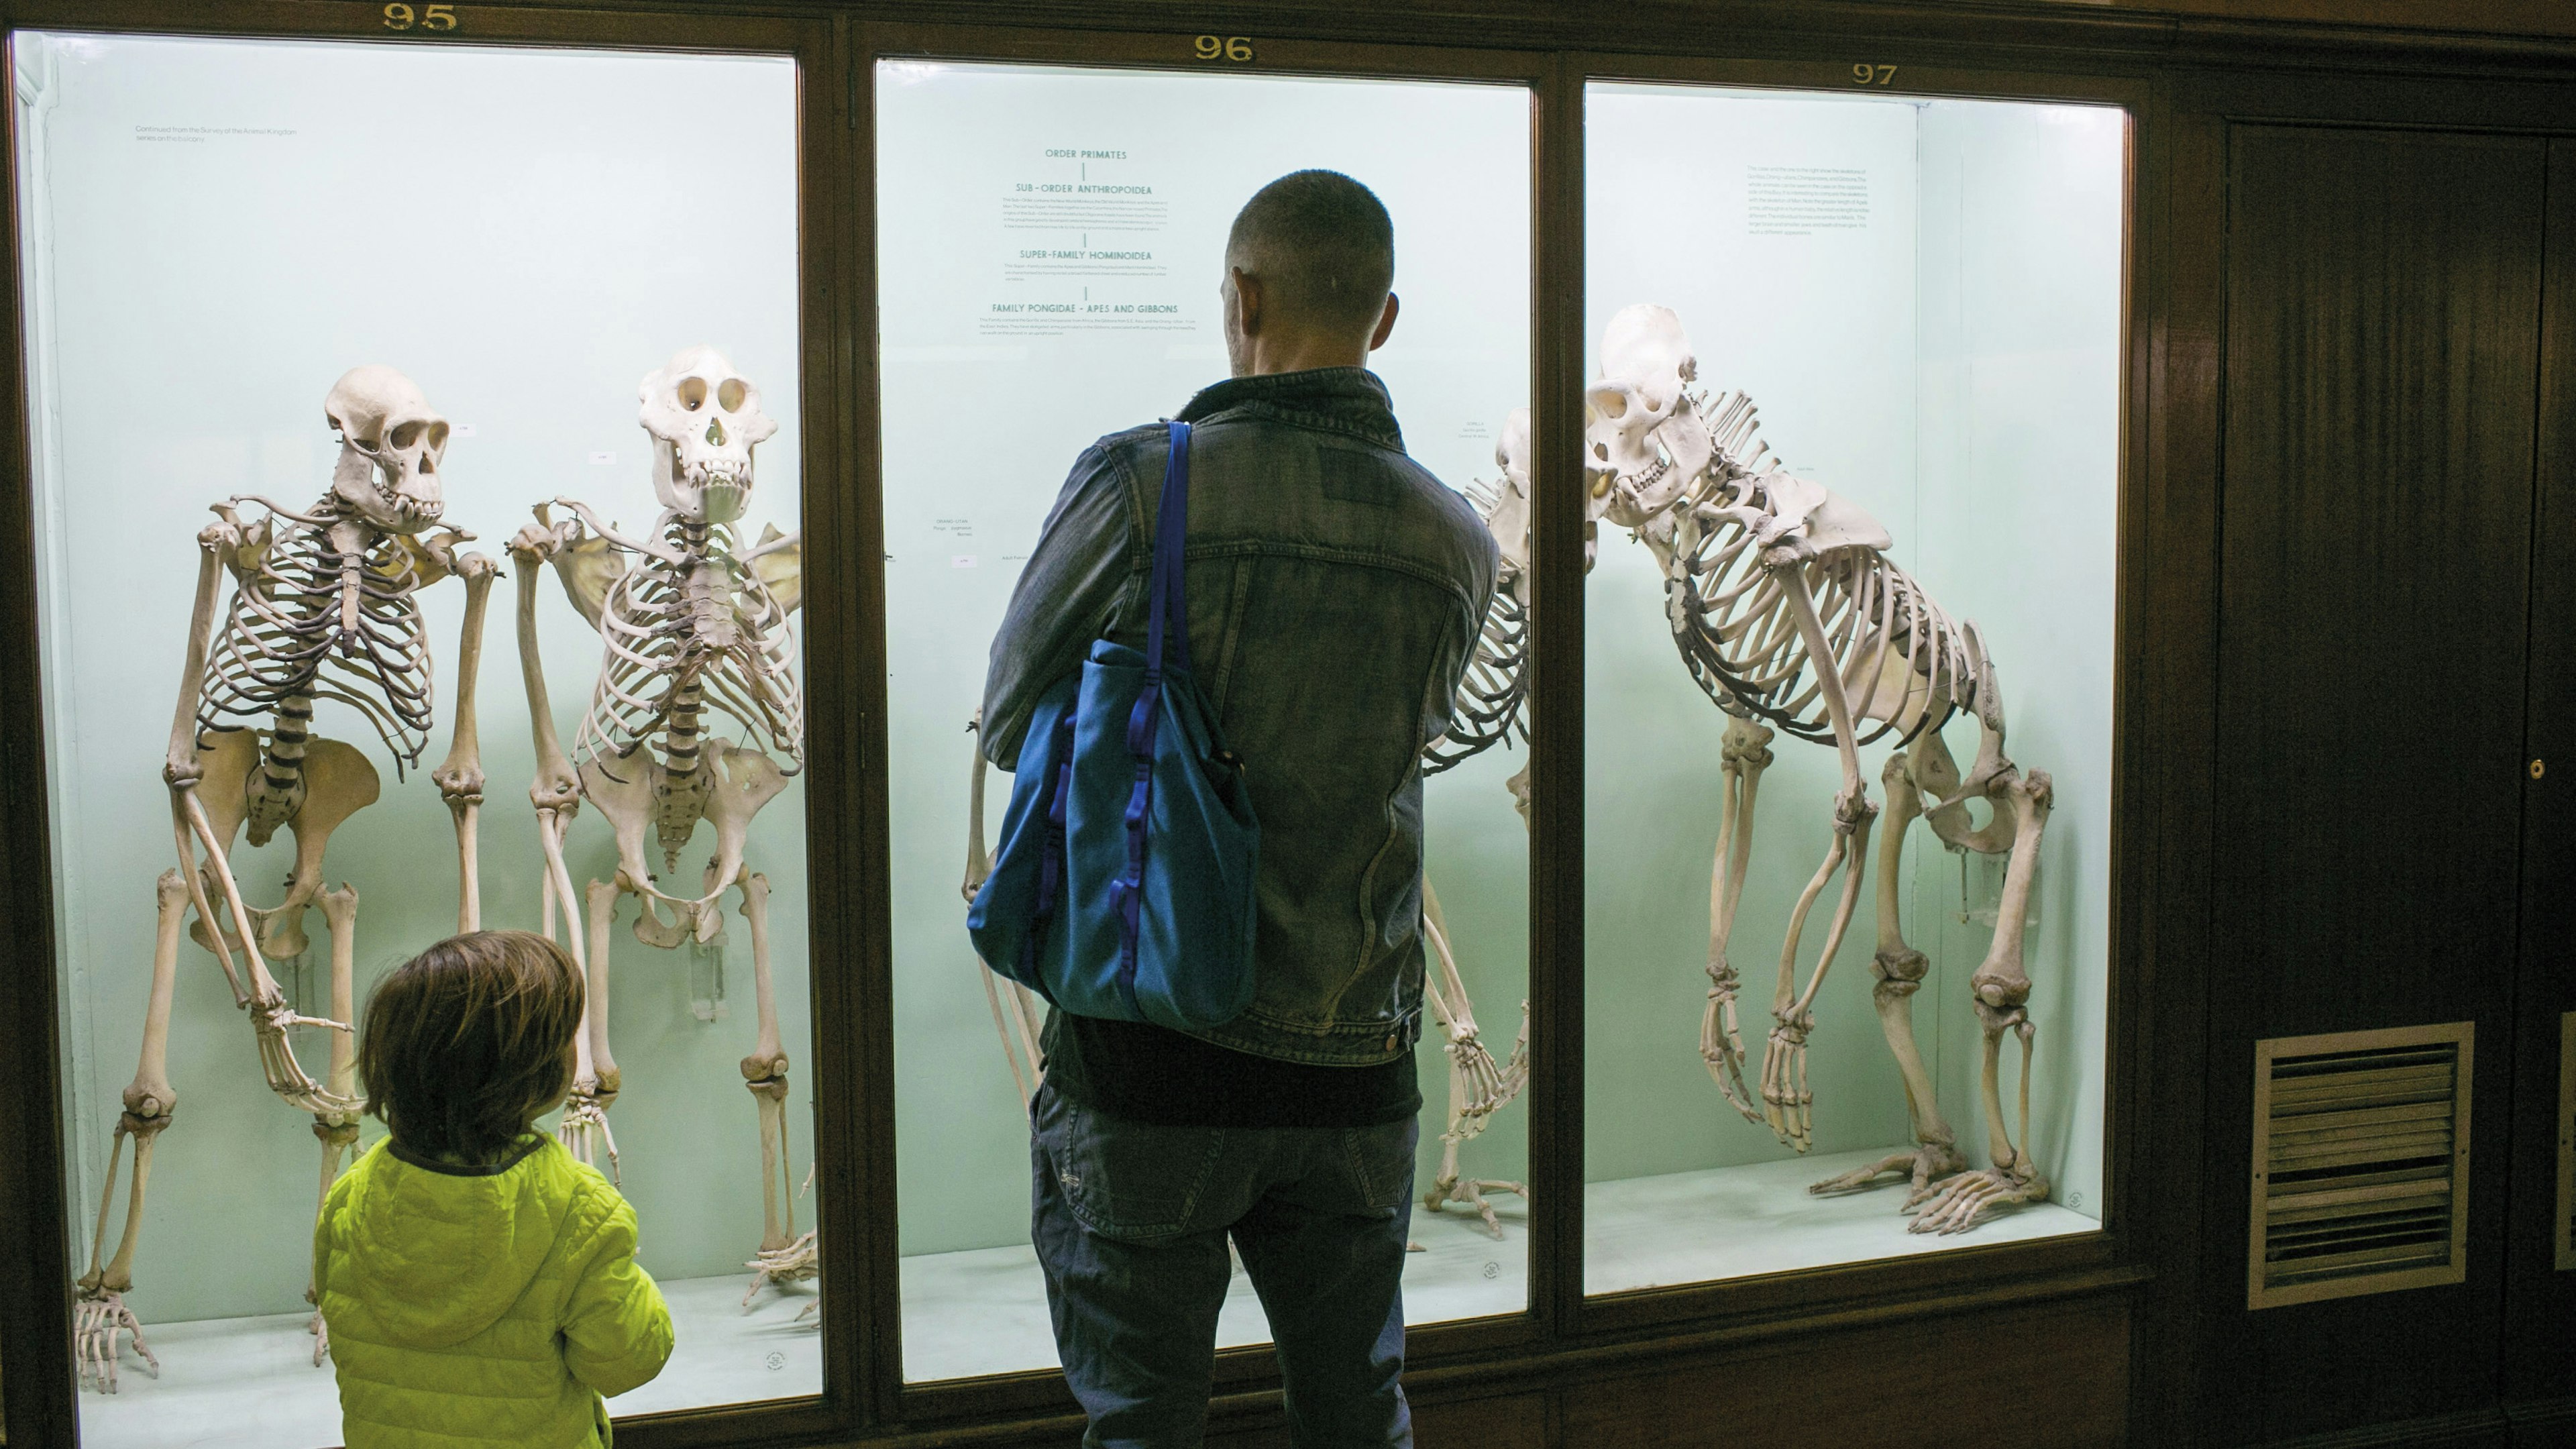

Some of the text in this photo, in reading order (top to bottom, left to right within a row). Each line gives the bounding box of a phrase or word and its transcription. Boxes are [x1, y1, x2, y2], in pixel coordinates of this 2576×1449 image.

[384, 3, 456, 30] 95
[1195, 36, 1252, 61] 96
[1853, 64, 1897, 85] 97
[267, 128, 297, 136] Kingdom
[1046, 150, 1127, 160] ORDER PRIMATES
[1077, 184, 1152, 195] ANTHROPOIDEA
[1020, 250, 1152, 260] SUPER-FAMILY HOMINOIDEA
[992, 304, 1025, 313] FAMILY
[1028, 304, 1075, 313] PONGIDAE
[1087, 305, 1110, 313] APES
[1114, 305, 1134, 313] AND
[1137, 305, 1178, 313] GIBBONS
